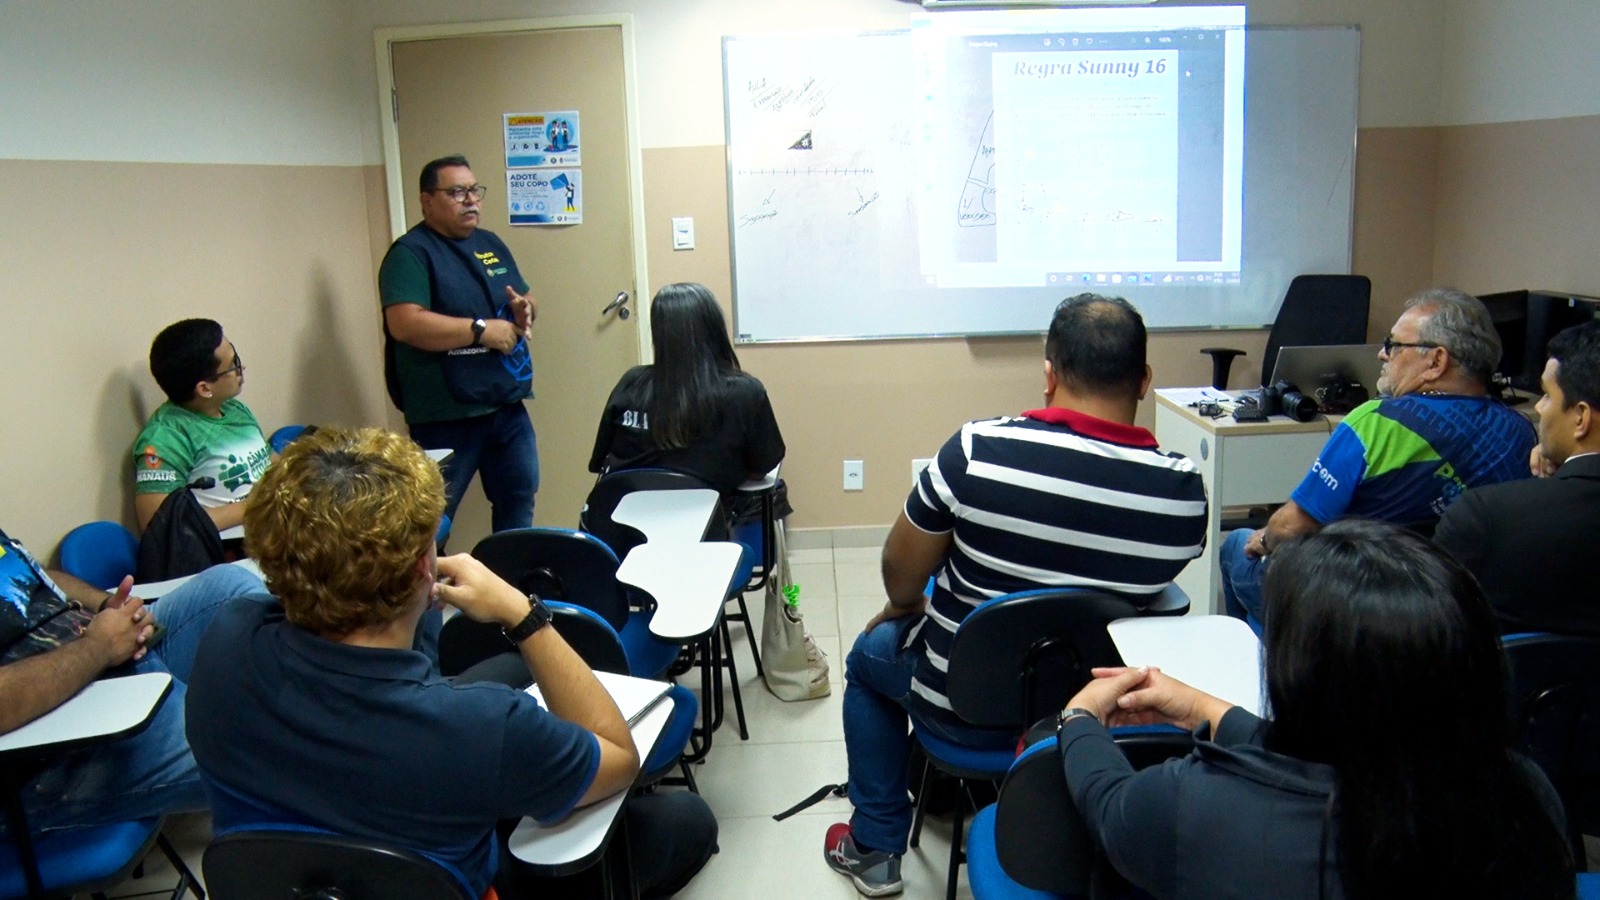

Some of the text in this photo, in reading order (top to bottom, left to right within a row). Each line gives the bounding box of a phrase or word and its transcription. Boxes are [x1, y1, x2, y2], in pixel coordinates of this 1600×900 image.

[1014, 58, 1167, 79] Regra Sunny 16
